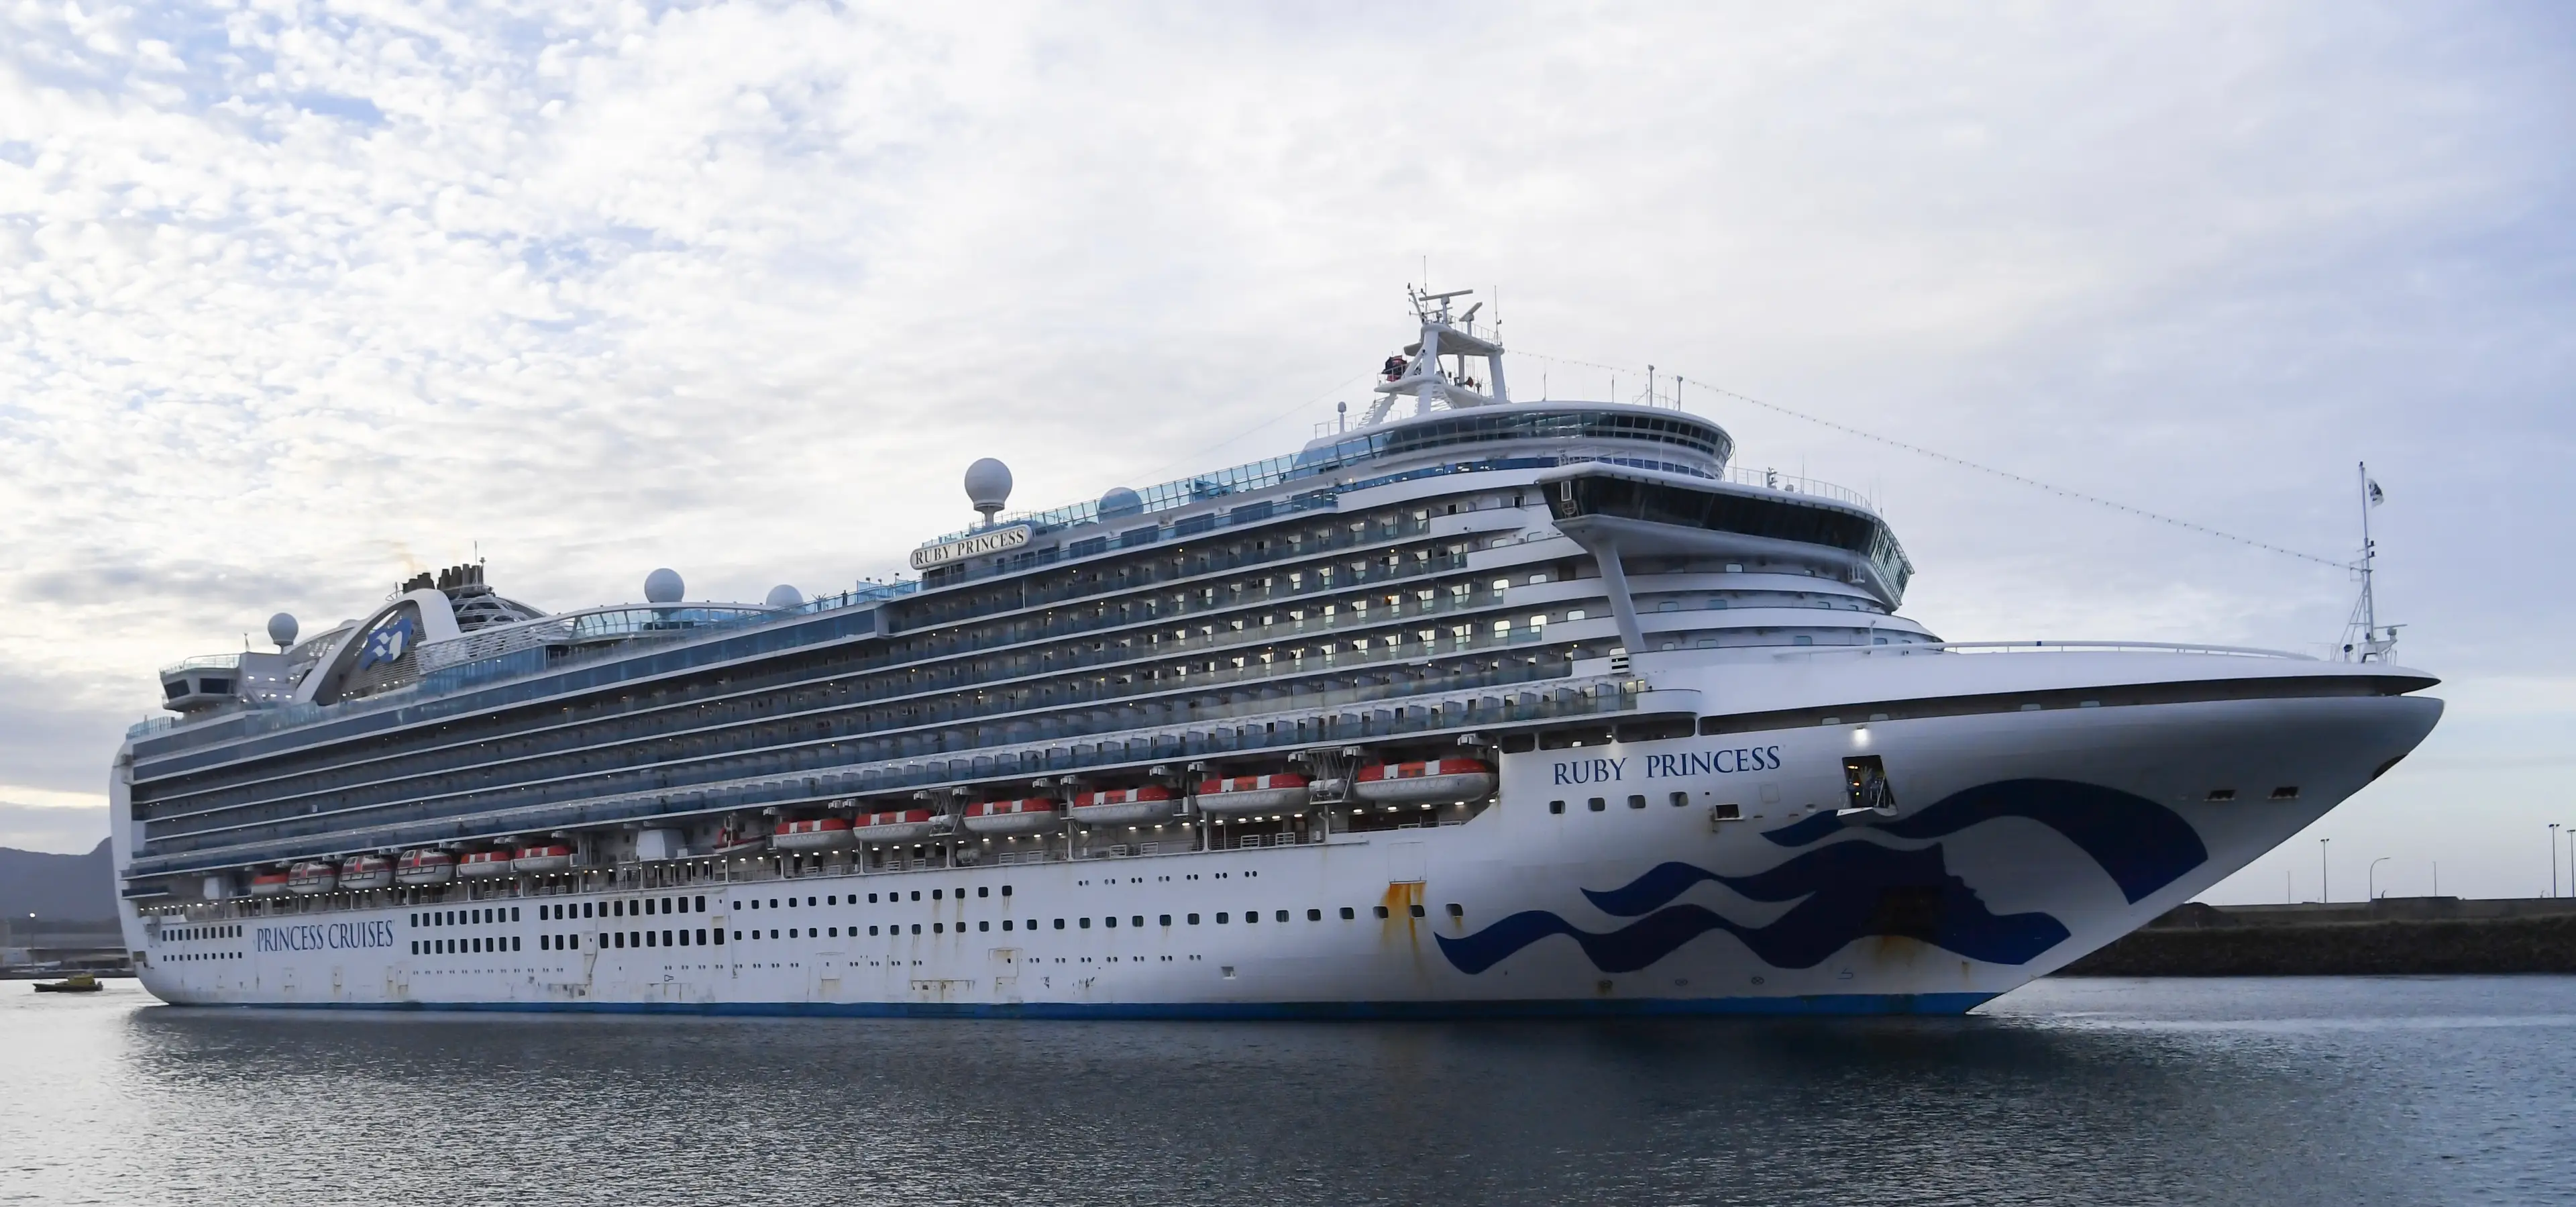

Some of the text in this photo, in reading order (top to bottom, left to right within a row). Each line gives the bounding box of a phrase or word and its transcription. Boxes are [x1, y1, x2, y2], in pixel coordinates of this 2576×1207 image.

[915, 529, 1024, 565] RUBY PRINCESS
[1553, 745, 1781, 786] RUBY PRINCESS
[256, 919, 394, 953] PRINCESS CRUISES
